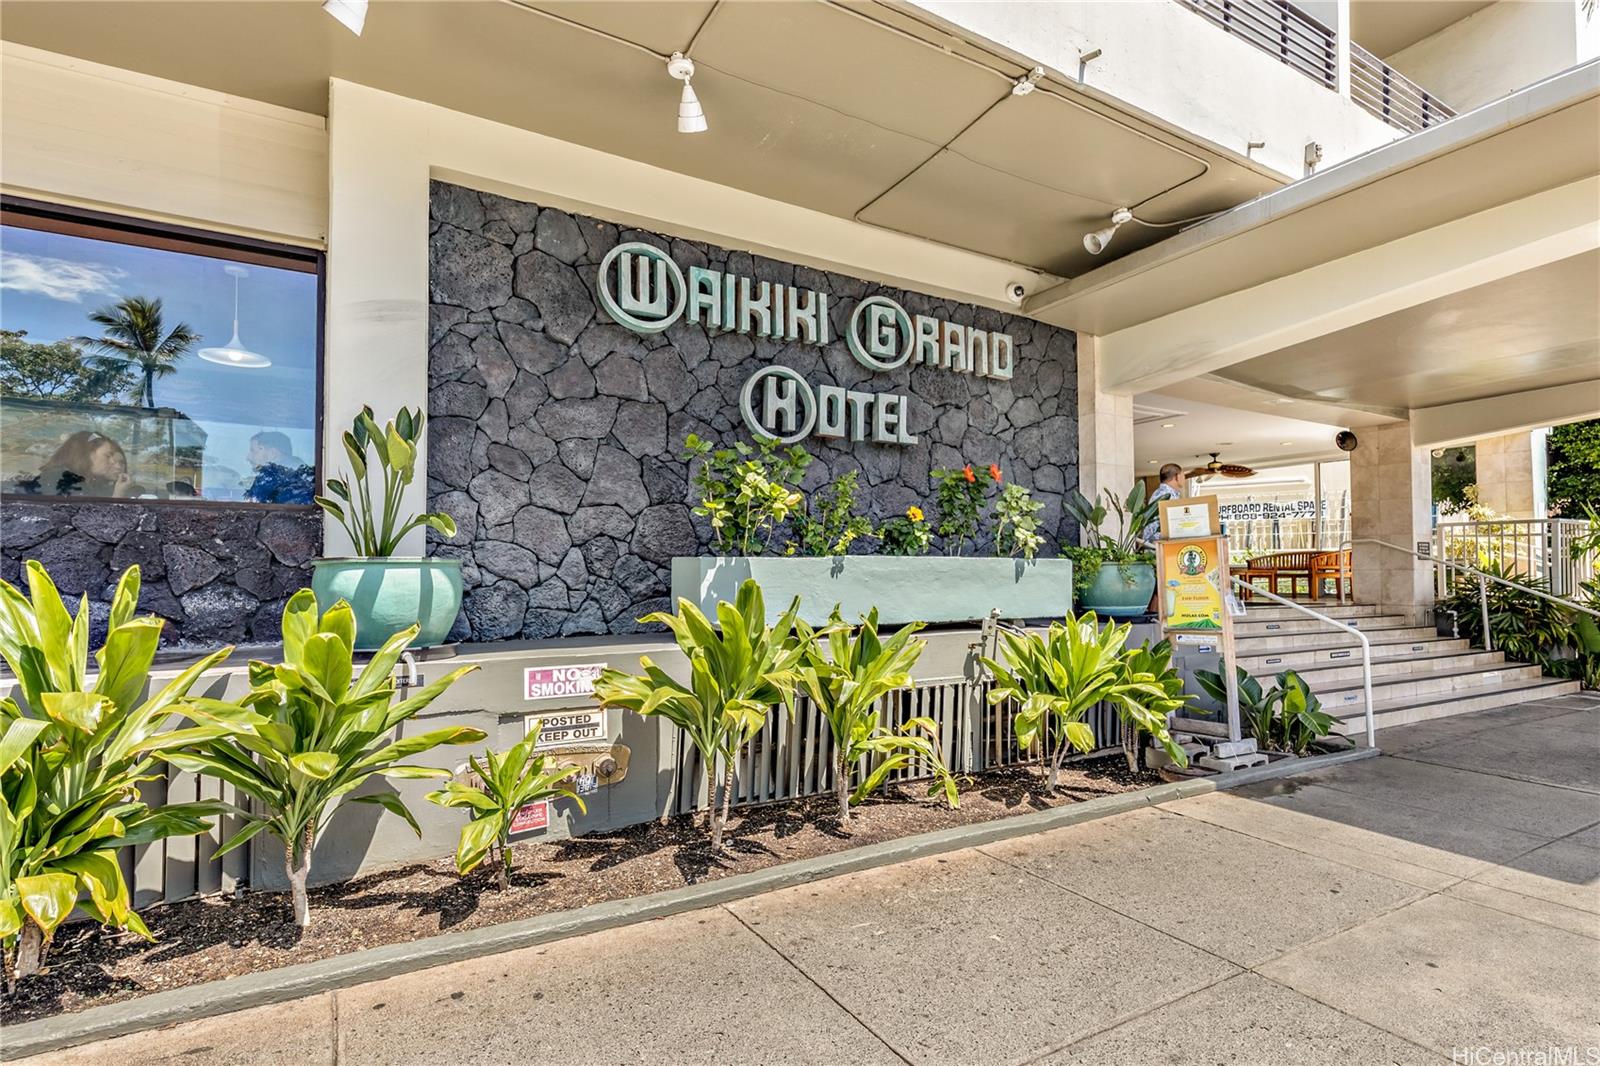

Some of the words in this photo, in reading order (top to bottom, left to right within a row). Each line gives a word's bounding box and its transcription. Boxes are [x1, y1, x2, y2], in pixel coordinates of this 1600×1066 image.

[616, 250, 829, 346] WAIKIKI
[862, 301, 1014, 382] GRAND
[757, 373, 919, 446] HOTEL
[1297, 500, 1326, 511] SPAE
[1234, 511, 1325, 520] 808-924-777
[552, 668, 581, 683] NO
[530, 680, 600, 698] SMOKIN
[543, 714, 591, 727] POSTED
[537, 730, 569, 743] KEEP
[573, 728, 598, 739] OUT
